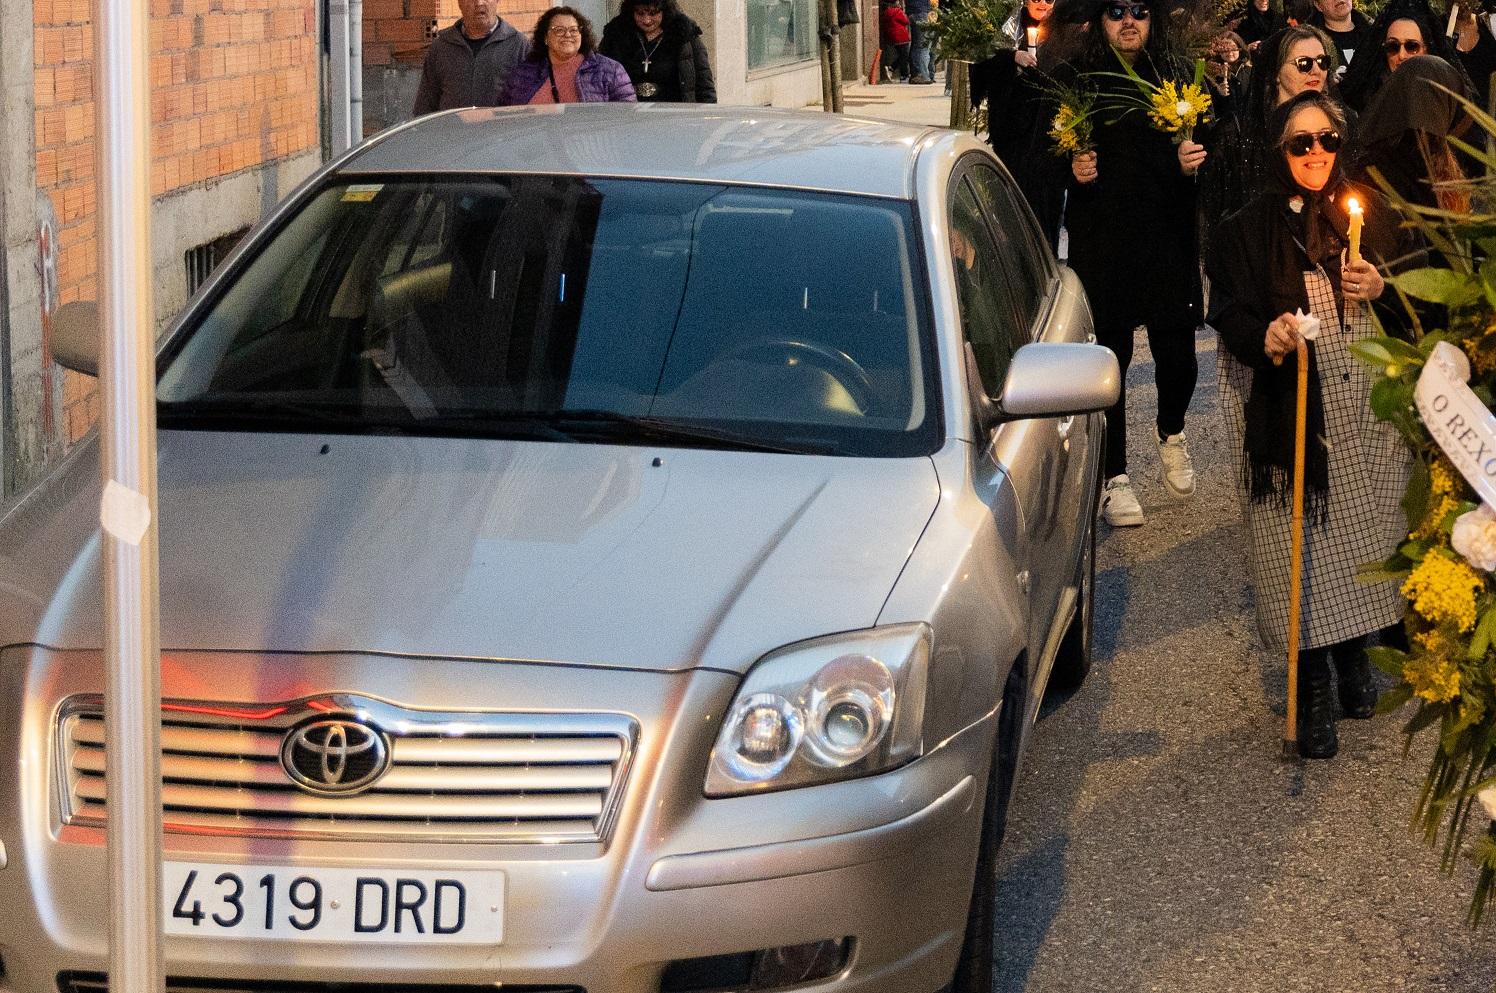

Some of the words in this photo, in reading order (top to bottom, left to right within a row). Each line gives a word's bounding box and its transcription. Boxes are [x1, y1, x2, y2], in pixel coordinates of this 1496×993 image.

[1432, 394, 1449, 413] O
[172, 869, 323, 931] 4319
[354, 876, 467, 935] DRD
